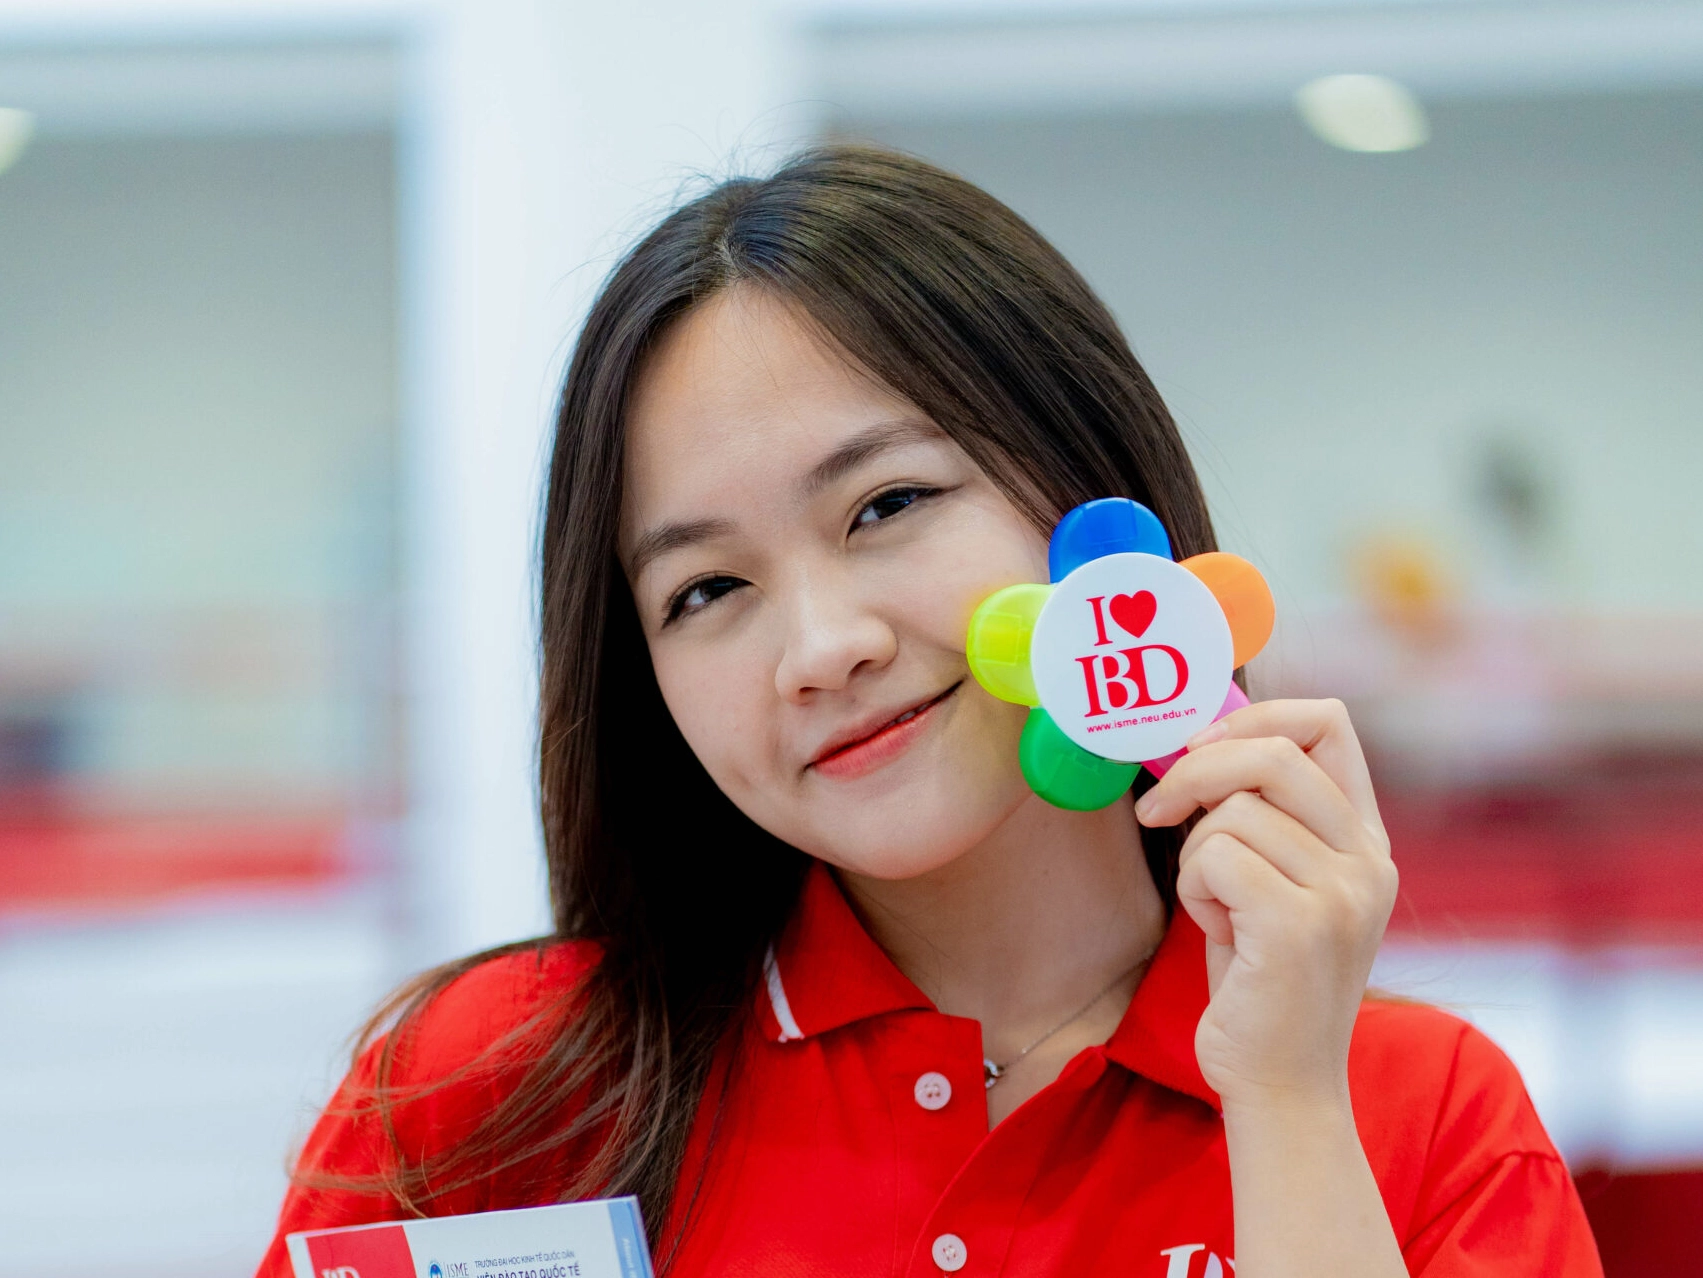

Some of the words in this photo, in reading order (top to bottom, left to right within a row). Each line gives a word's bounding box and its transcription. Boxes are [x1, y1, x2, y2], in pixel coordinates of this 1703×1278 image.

[1086, 596, 1113, 646] I
[1075, 644, 1189, 718] IBD
[1087, 706, 1197, 733] www.isme.neu.edu.vn
[447, 1262, 469, 1278] ISME
[568, 1260, 581, 1277] TẾ
